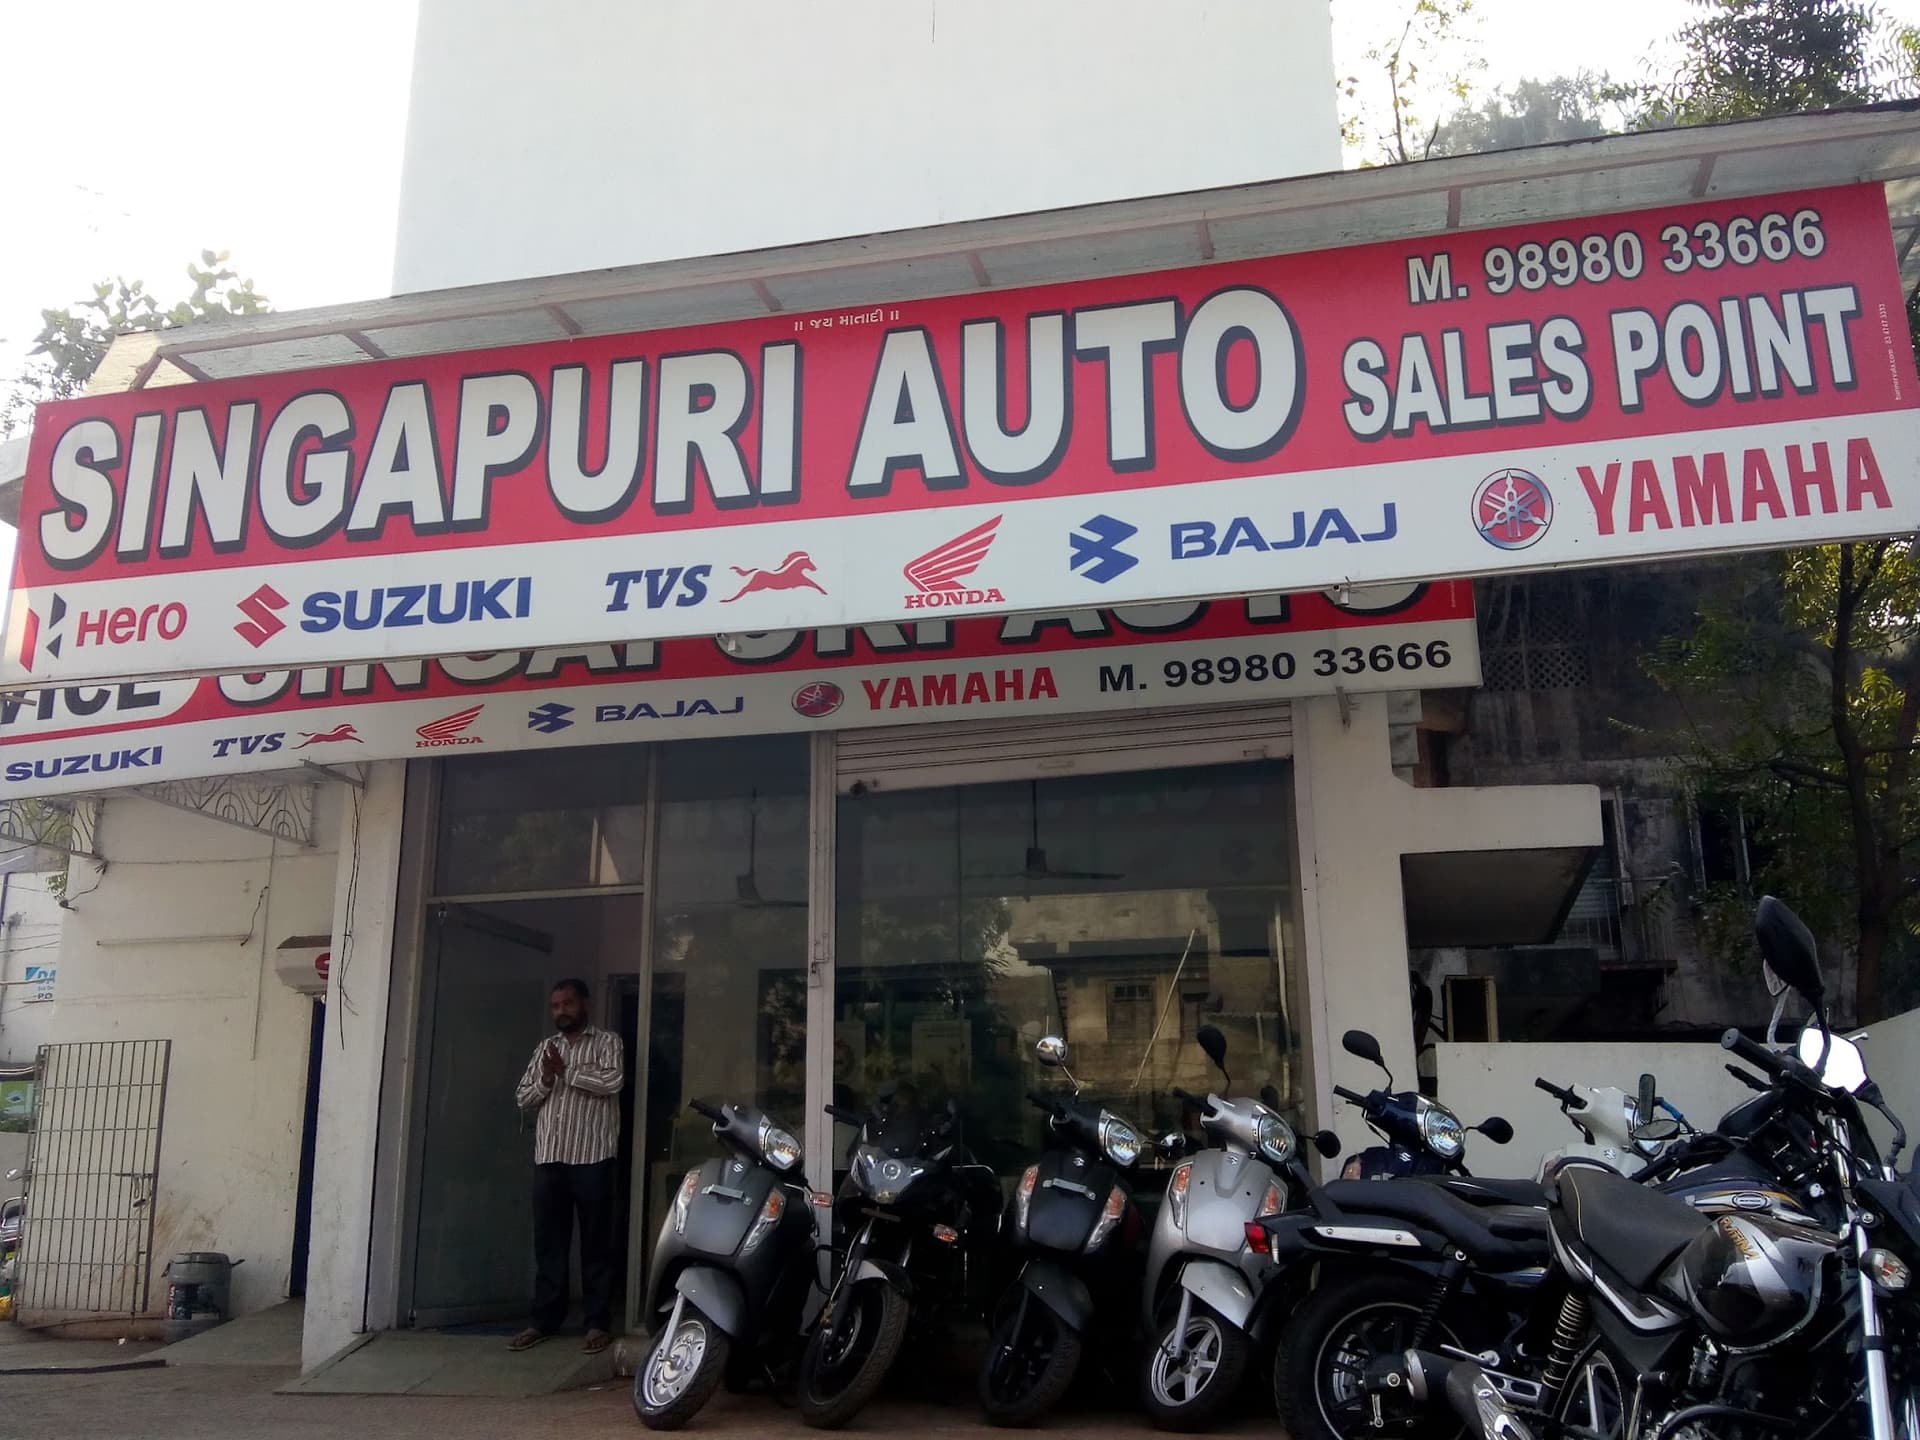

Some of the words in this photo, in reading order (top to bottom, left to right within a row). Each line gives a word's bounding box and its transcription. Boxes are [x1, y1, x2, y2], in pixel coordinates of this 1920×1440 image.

[1406, 251, 1469, 305] M.
[1483, 230, 1645, 295] 98980
[1660, 207, 1826, 275] 33666
[1341, 313, 1592, 442] SALES
[1609, 285, 1860, 415] POINT
[39, 340, 802, 570] SINGAPURI
[846, 284, 1307, 498] AUTO
[1576, 437, 1892, 536] YAMAHA
[1170, 502, 1398, 560] BAJAJ
[301, 576, 532, 633] SUZUKI
[605, 563, 712, 613] TVS
[904, 588, 1006, 610] HONDA
[75, 601, 188, 647] Hero
[861, 667, 1059, 711] YAMAHA
[1100, 664, 1148, 692] M.
[1163, 652, 1296, 687] 98980
[1313, 640, 1451, 676] 33666
[595, 696, 744, 723] BAJAJ
[5, 745, 163, 782] SUZUKI
[212, 731, 286, 759] TVS
[415, 736, 484, 749] HONDA
